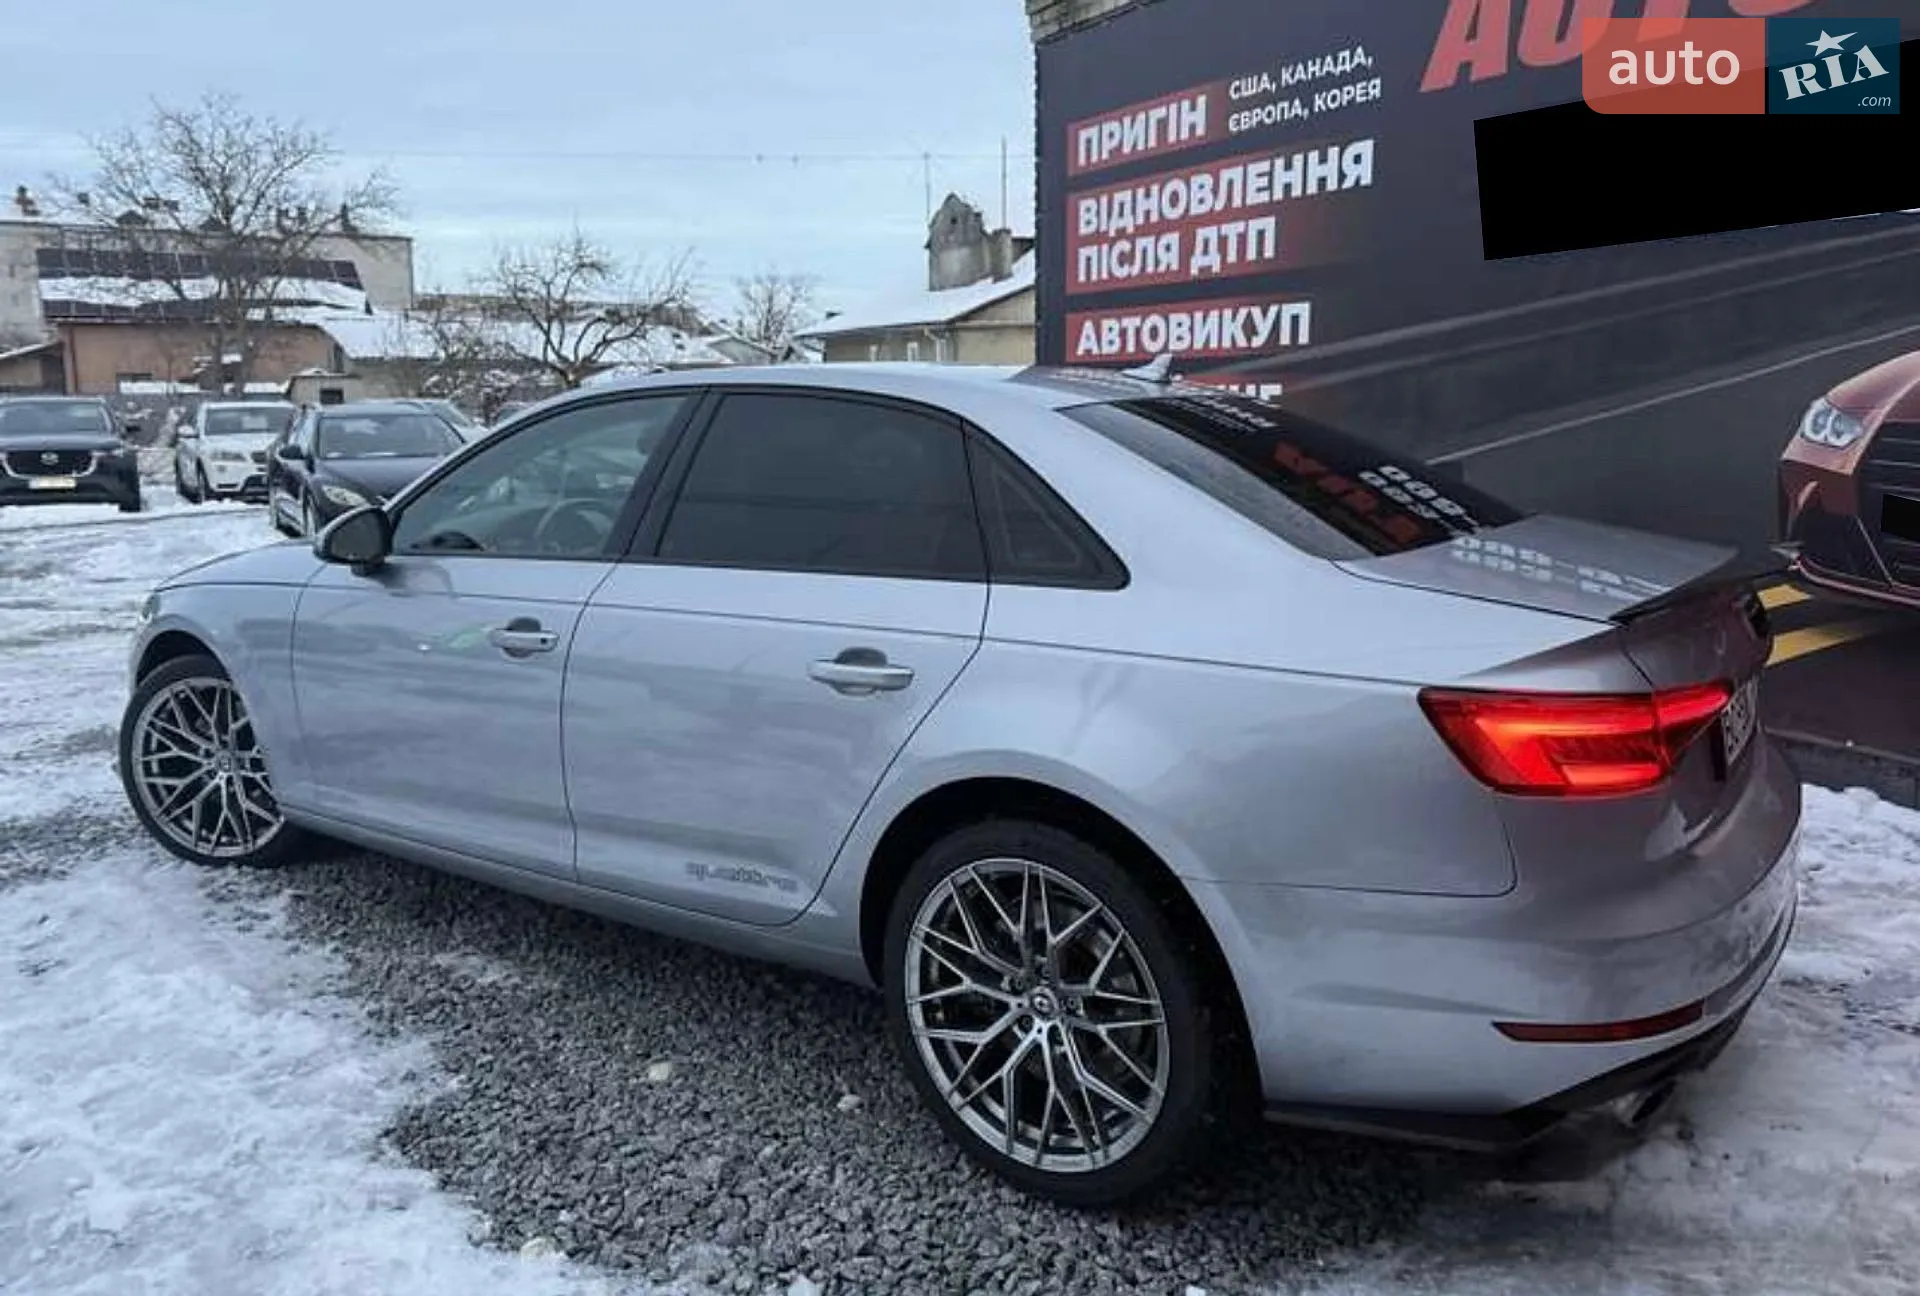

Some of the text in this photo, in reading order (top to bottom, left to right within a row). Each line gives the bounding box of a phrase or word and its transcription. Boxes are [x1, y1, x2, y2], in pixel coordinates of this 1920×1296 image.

[1229, 46, 1373, 101] США, КАНАДА,
[1077, 94, 1208, 167] ПРИГІН
[1228, 78, 1382, 133] ЄВРОПА, КОРЕЯ
[1077, 139, 1375, 237] ВІДНОВЛЕННЯ
[1077, 216, 1276, 283] ПІСЛЯ ДТП
[1076, 302, 1312, 356] АВТОВИКУП
